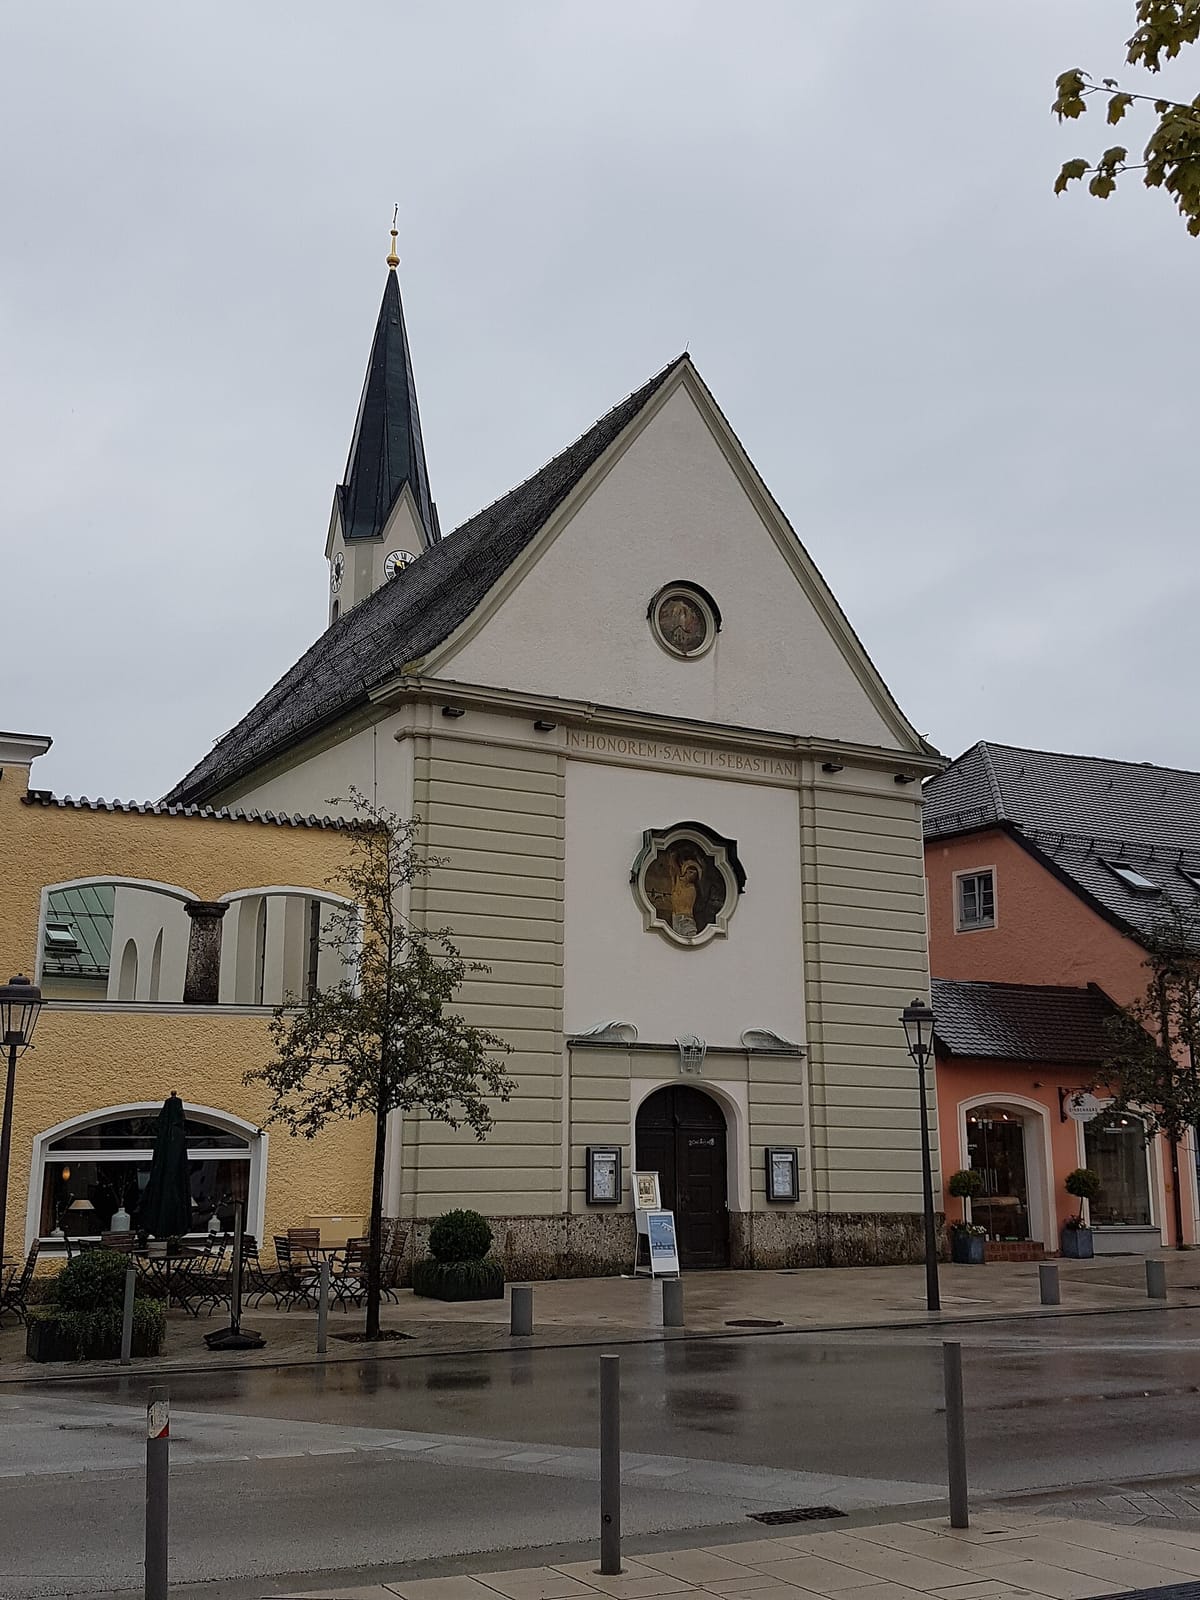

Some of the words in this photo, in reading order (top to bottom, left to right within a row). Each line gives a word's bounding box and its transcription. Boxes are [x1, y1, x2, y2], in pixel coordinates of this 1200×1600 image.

[565, 731, 580, 746] IN
[585, 735, 658, 758] HONOREM
[663, 746, 714, 766] SANCTI
[718, 753, 797, 776] SEBASTIANI
